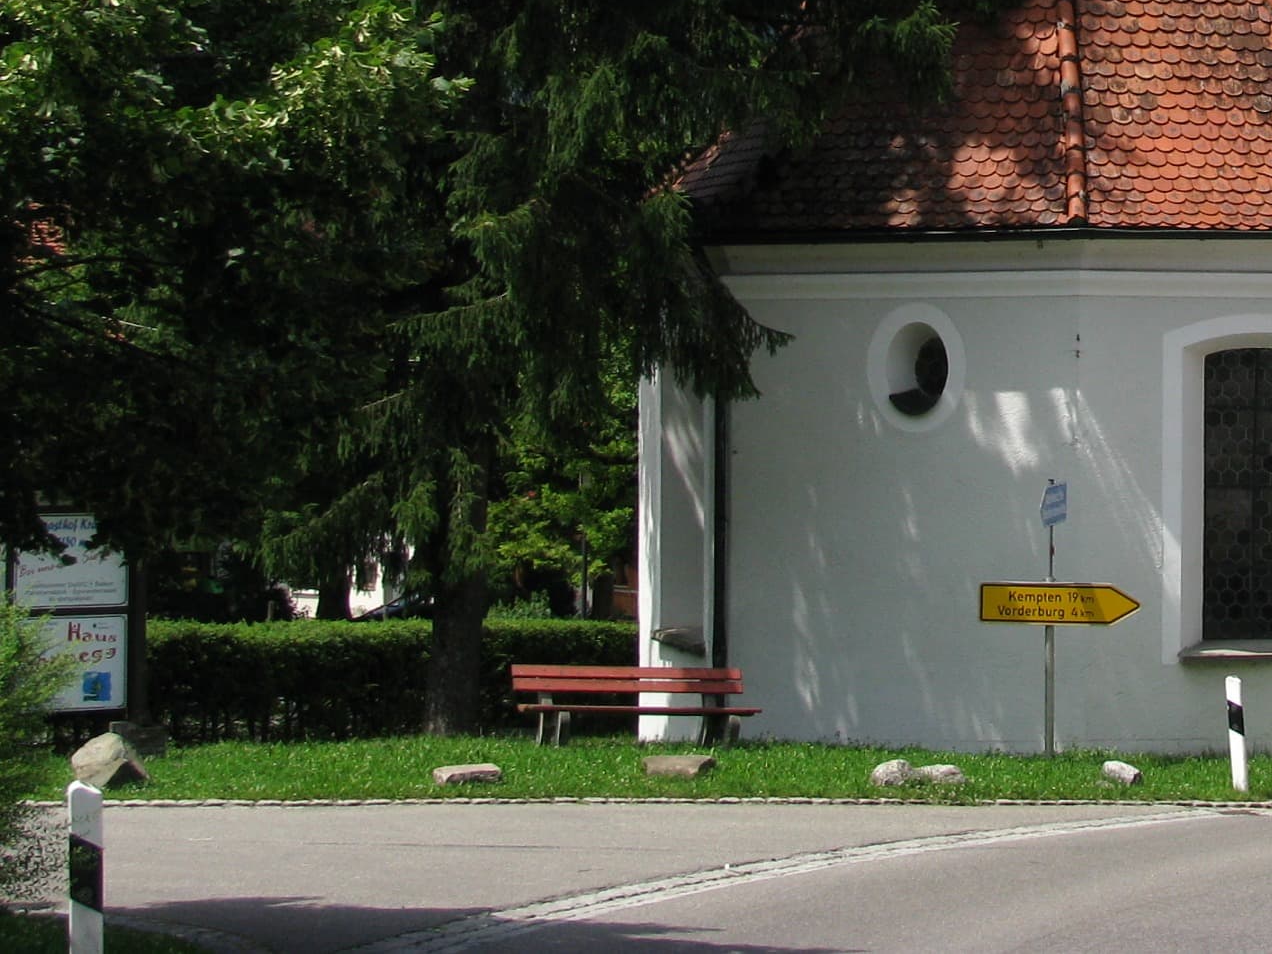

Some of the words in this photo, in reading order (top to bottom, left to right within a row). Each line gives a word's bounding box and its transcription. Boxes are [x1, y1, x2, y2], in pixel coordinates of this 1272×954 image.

[1008, 591, 1062, 603] Kempten
[1068, 591, 1079, 601] 19
[1080, 594, 1094, 603] km
[998, 606, 1064, 619] Vorderburg
[1071, 607, 1078, 617] 4
[67, 621, 117, 643] Haus
